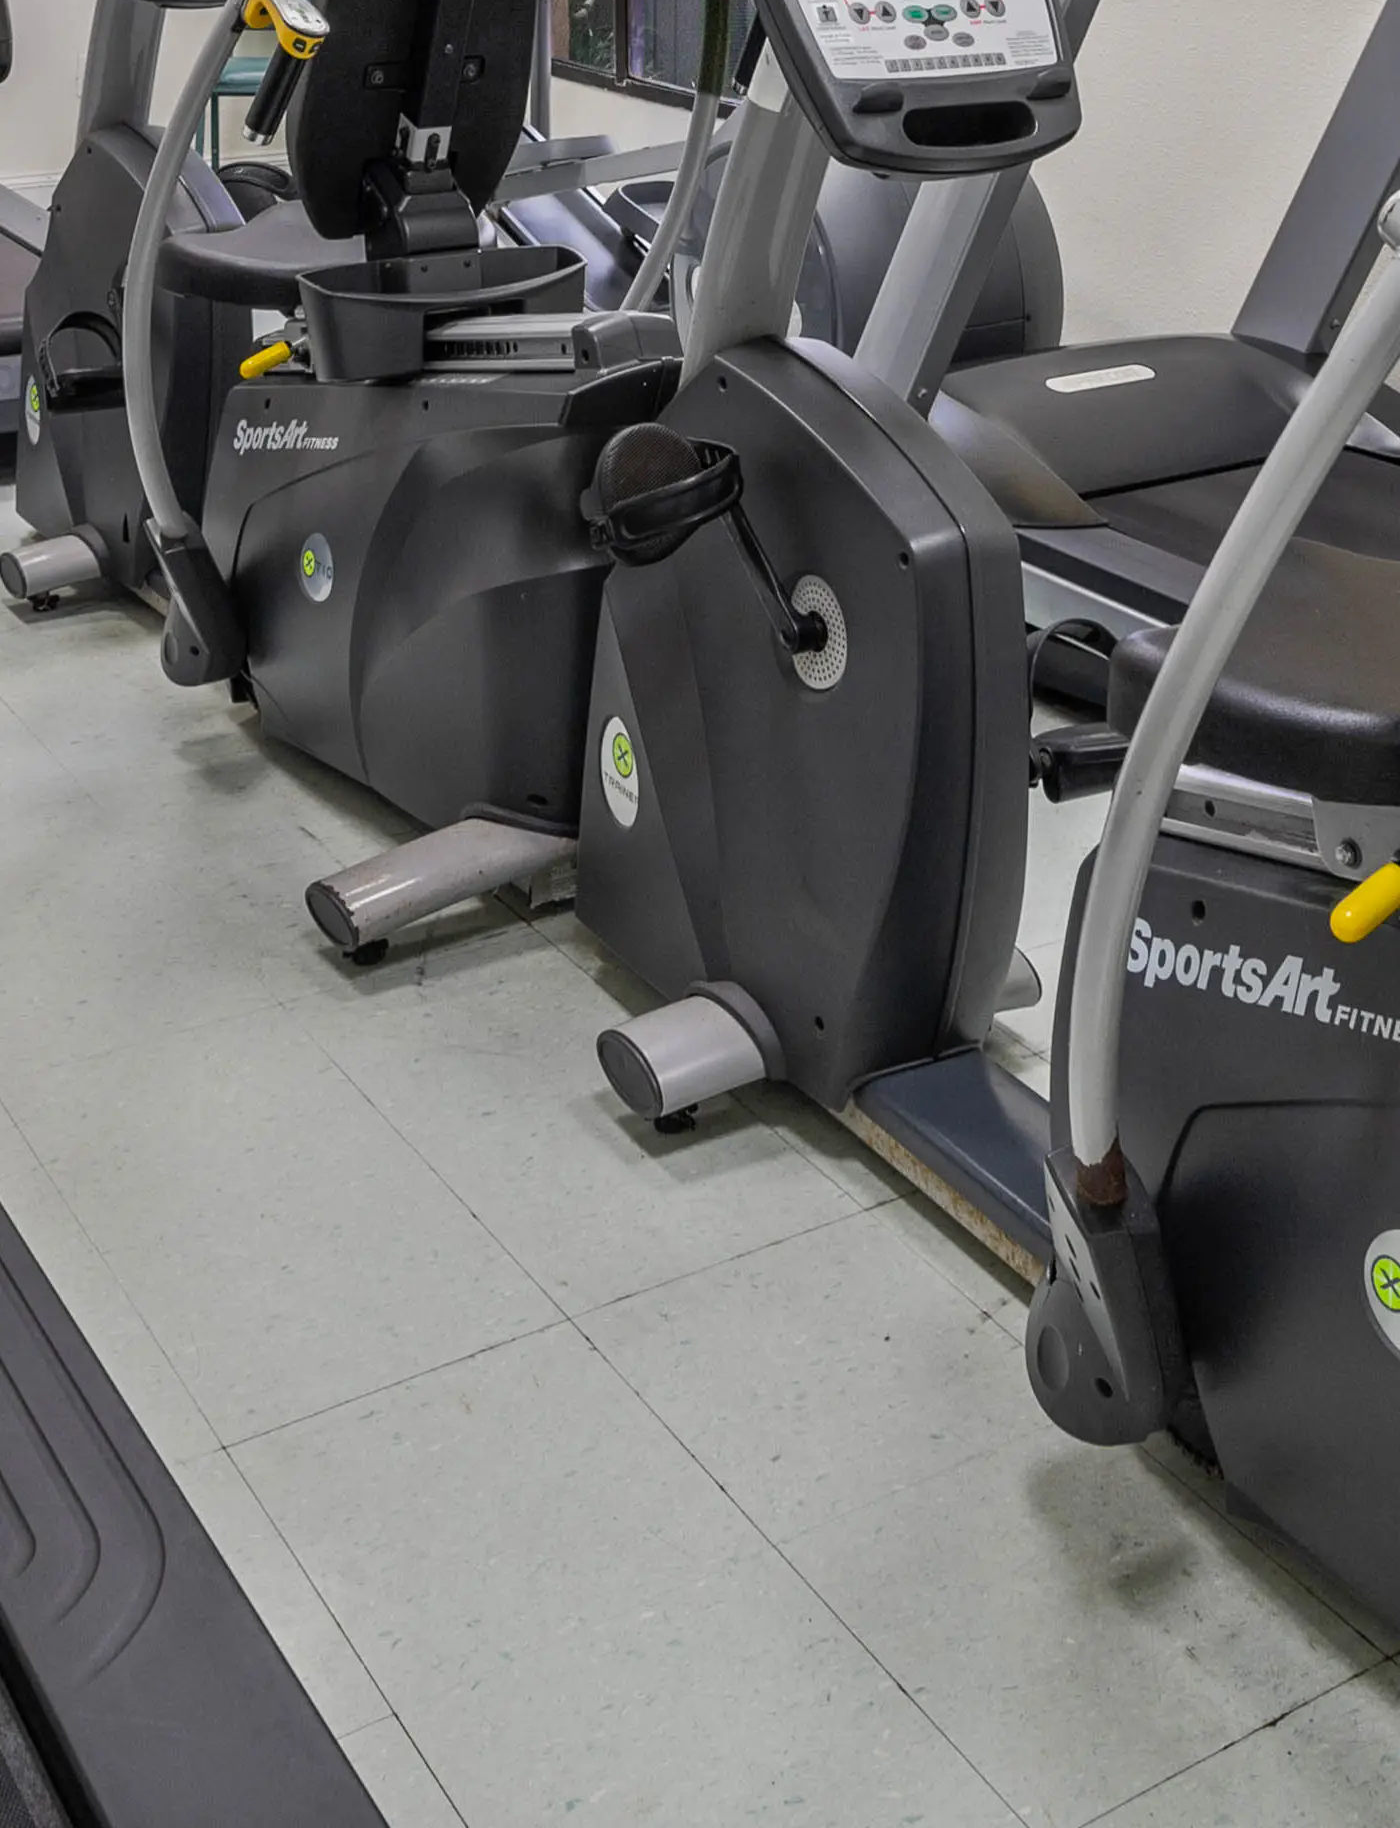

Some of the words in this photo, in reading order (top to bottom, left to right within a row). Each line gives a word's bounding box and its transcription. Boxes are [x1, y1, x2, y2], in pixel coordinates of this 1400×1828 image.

[233, 419, 308, 456] SportsArt
[302, 437, 339, 450] FITNESS
[1126, 917, 1341, 1024] SportsArt
